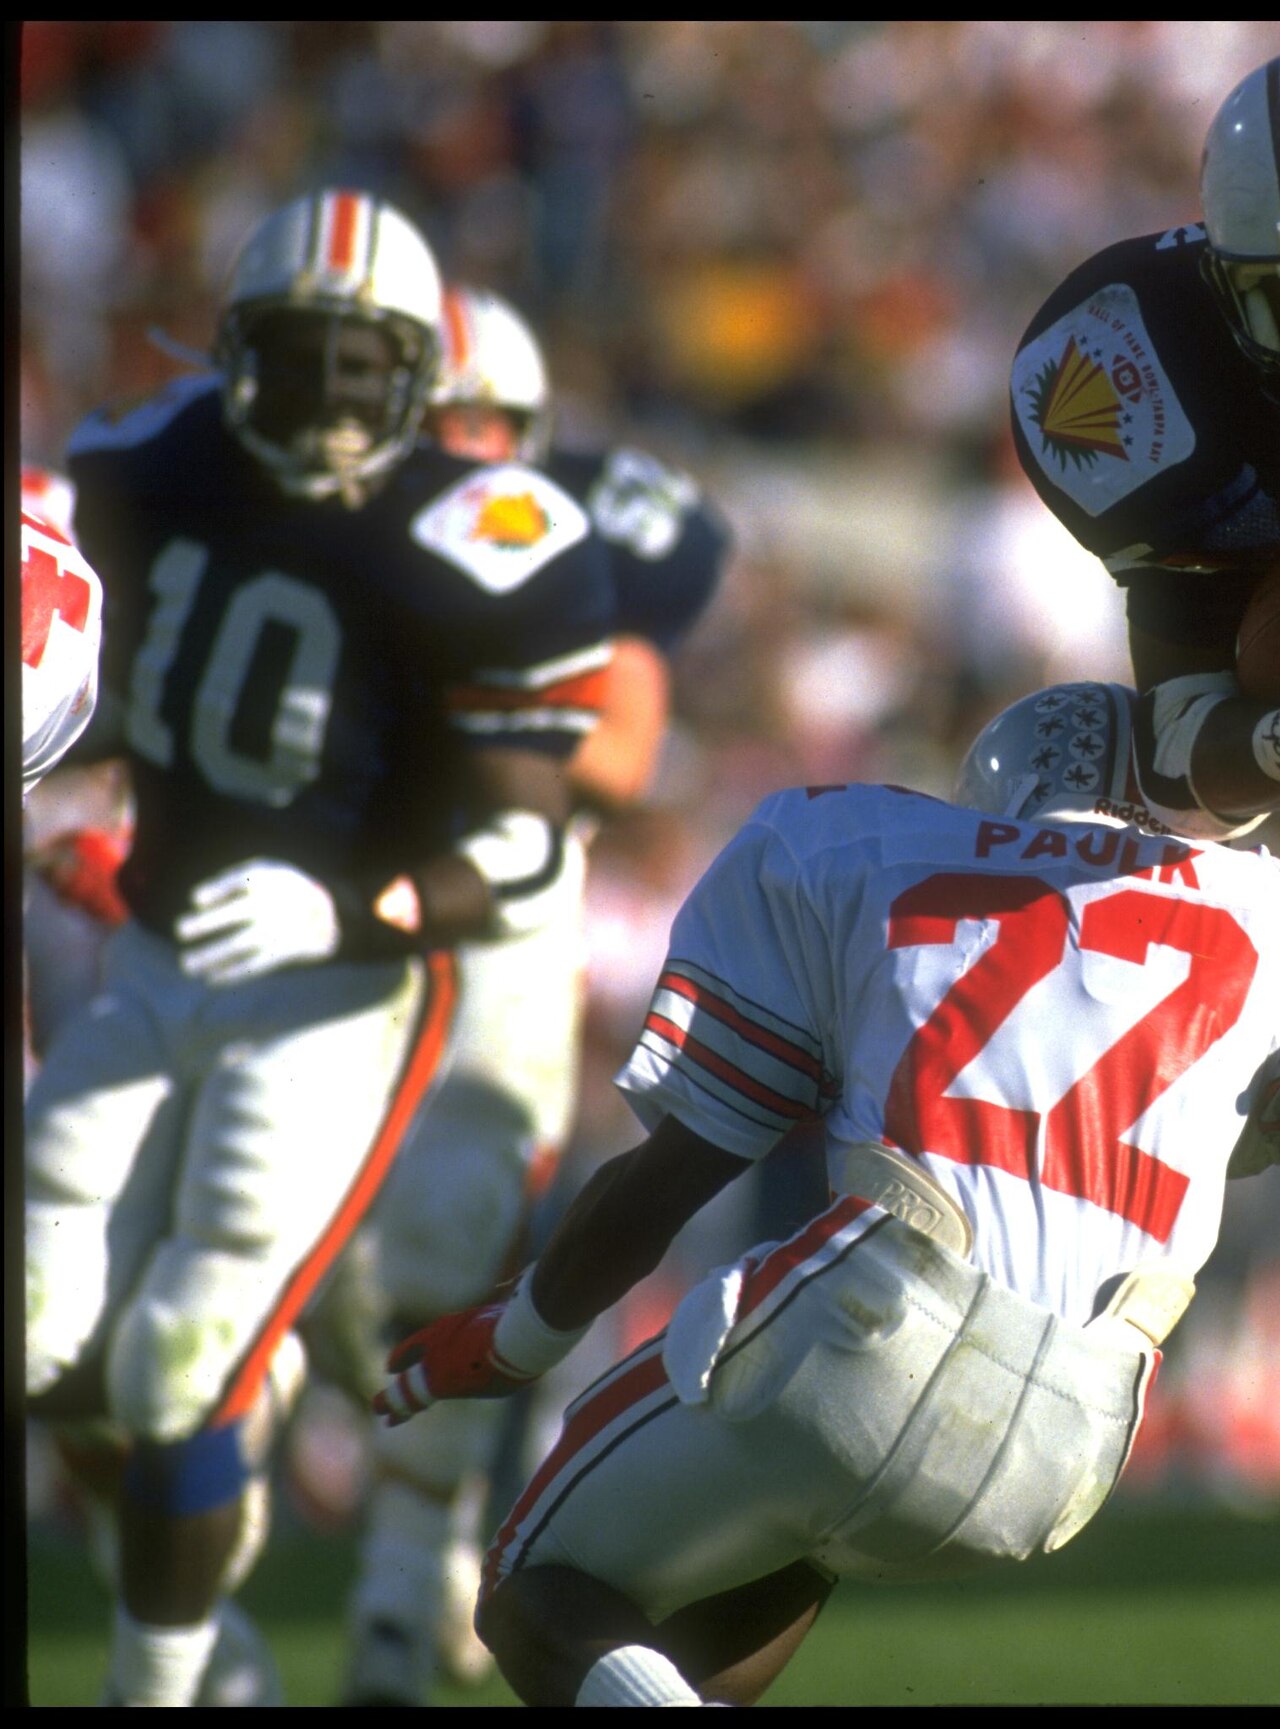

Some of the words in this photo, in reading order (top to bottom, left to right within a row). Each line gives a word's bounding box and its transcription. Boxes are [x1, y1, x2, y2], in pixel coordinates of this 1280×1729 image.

[1087, 305, 1111, 323] HALL
[1111, 319, 1126, 332] OF
[1124, 332, 1146, 360] FAME
[1149, 441, 1164, 463] BAY
[126, 537, 342, 807] 10
[975, 821, 1204, 890] PAULK
[883, 873, 1259, 1244] 22
